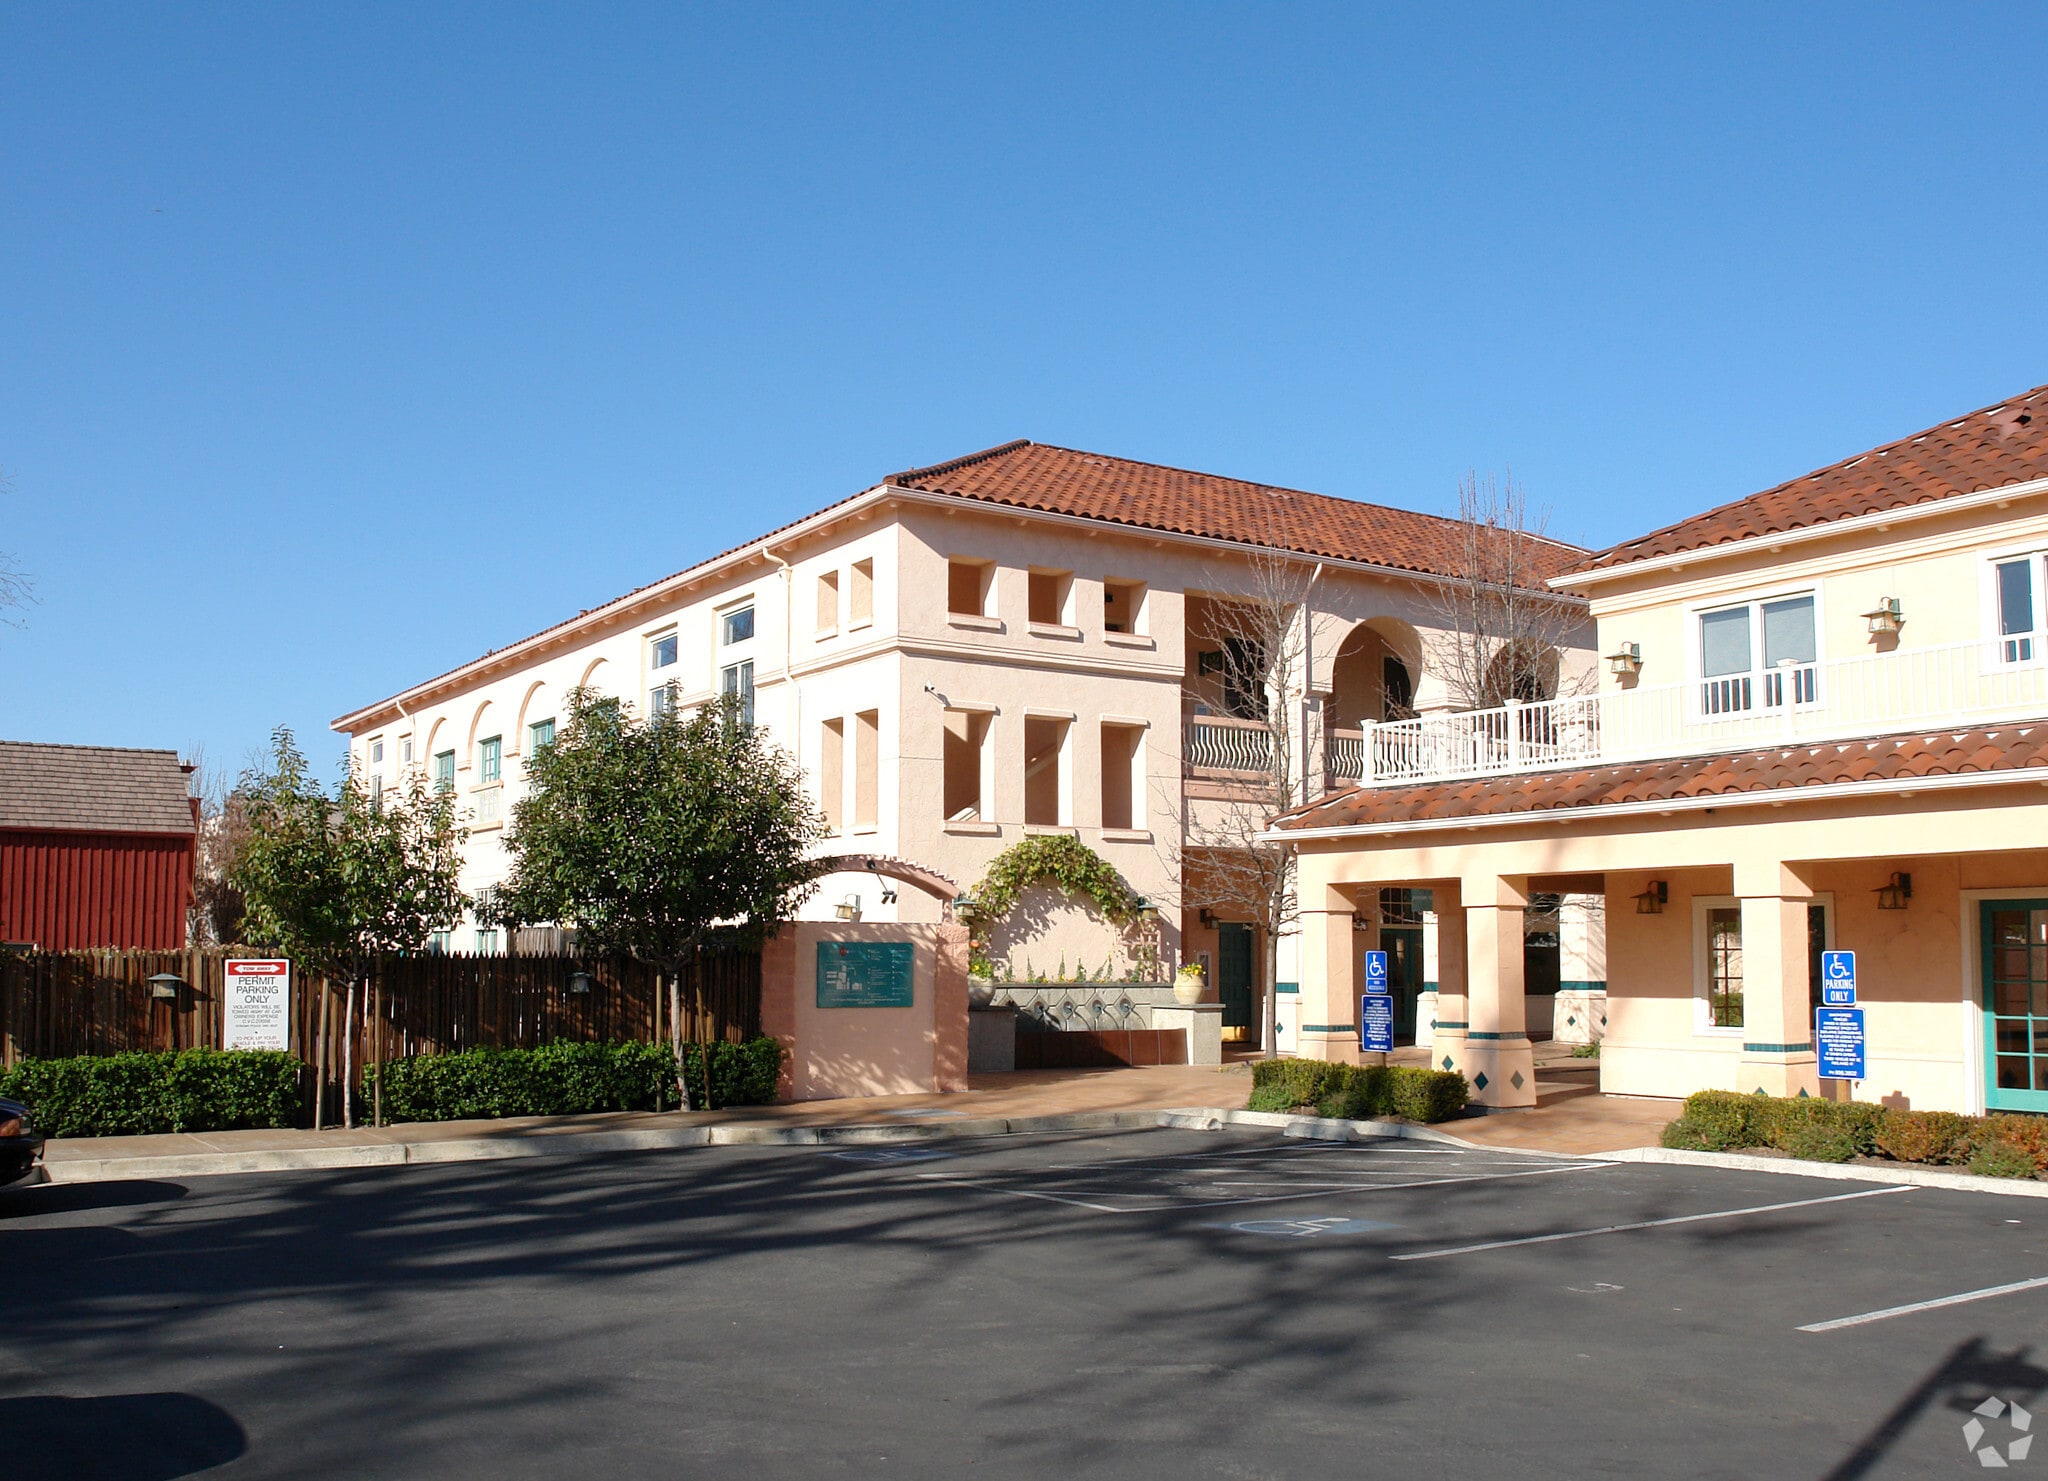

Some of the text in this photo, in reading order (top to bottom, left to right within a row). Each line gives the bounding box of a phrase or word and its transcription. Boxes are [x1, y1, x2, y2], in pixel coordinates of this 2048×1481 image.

[238, 976, 276, 985] PERMIT
[1825, 979, 1853, 990] PARKING
[236, 985, 279, 994] PARKING
[244, 995, 270, 1004] ONLY
[1830, 991, 1849, 1001] ONLY
